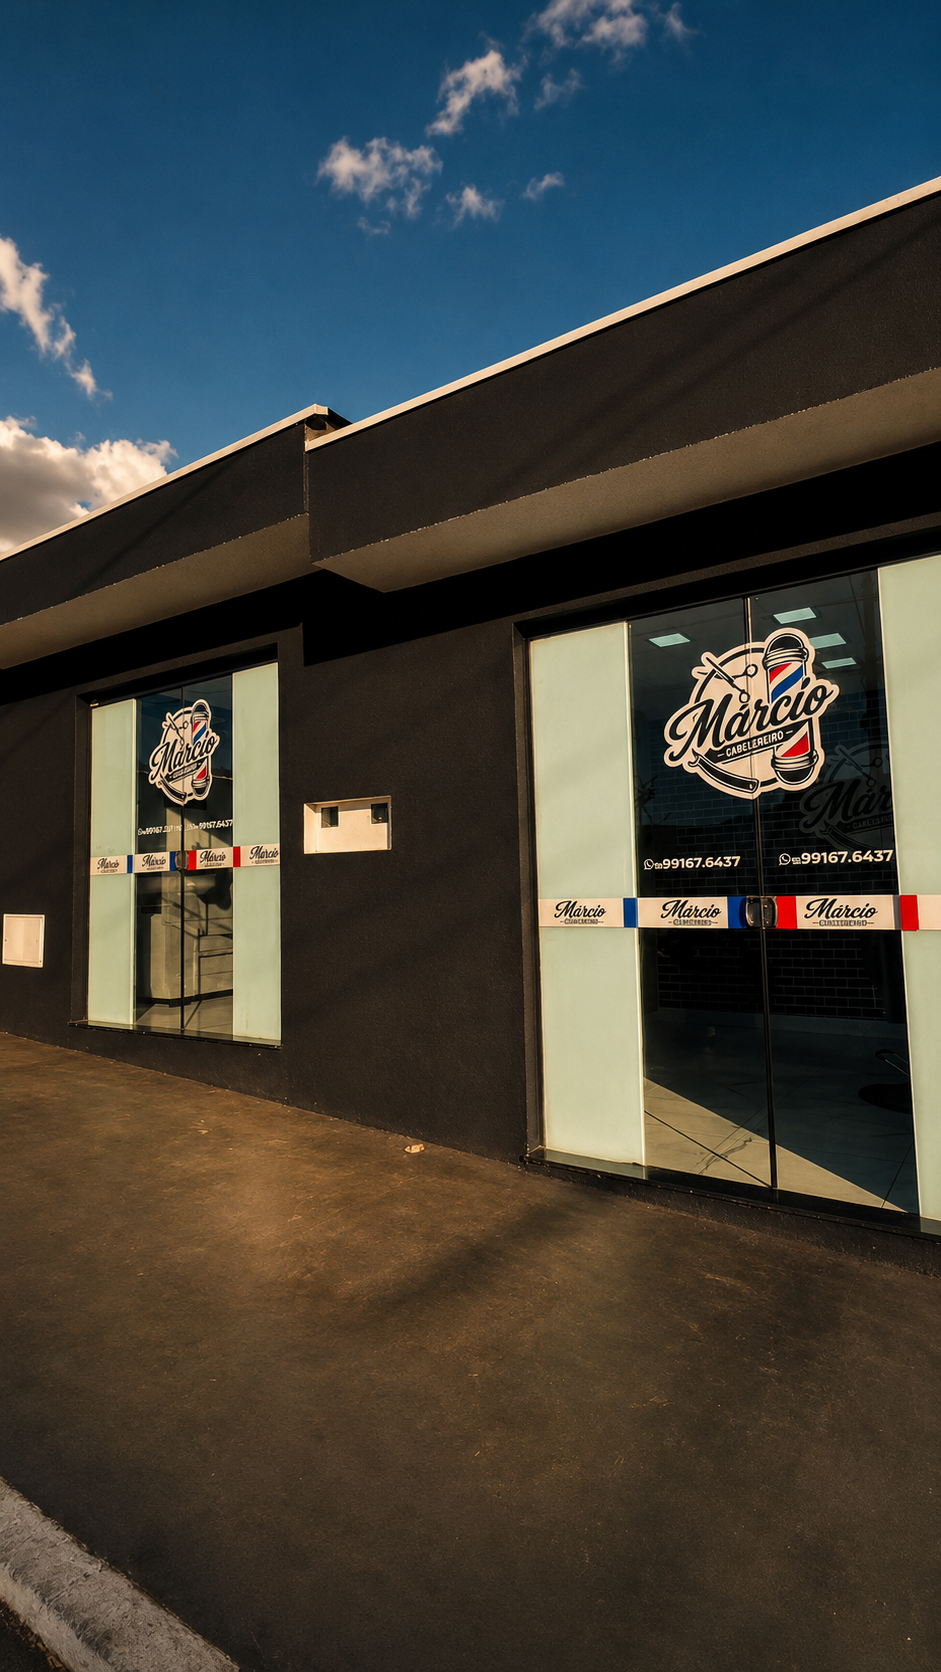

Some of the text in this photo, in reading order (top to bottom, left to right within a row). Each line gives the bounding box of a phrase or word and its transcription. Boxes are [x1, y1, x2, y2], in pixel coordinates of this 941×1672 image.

[668, 677, 834, 761] Márcio
[150, 730, 218, 780] Márcio
[725, 731, 785, 757] CABELEREIRO
[553, 900, 607, 918] Márcio
[660, 899, 721, 919] Márcio
[804, 898, 878, 919] Márcio
